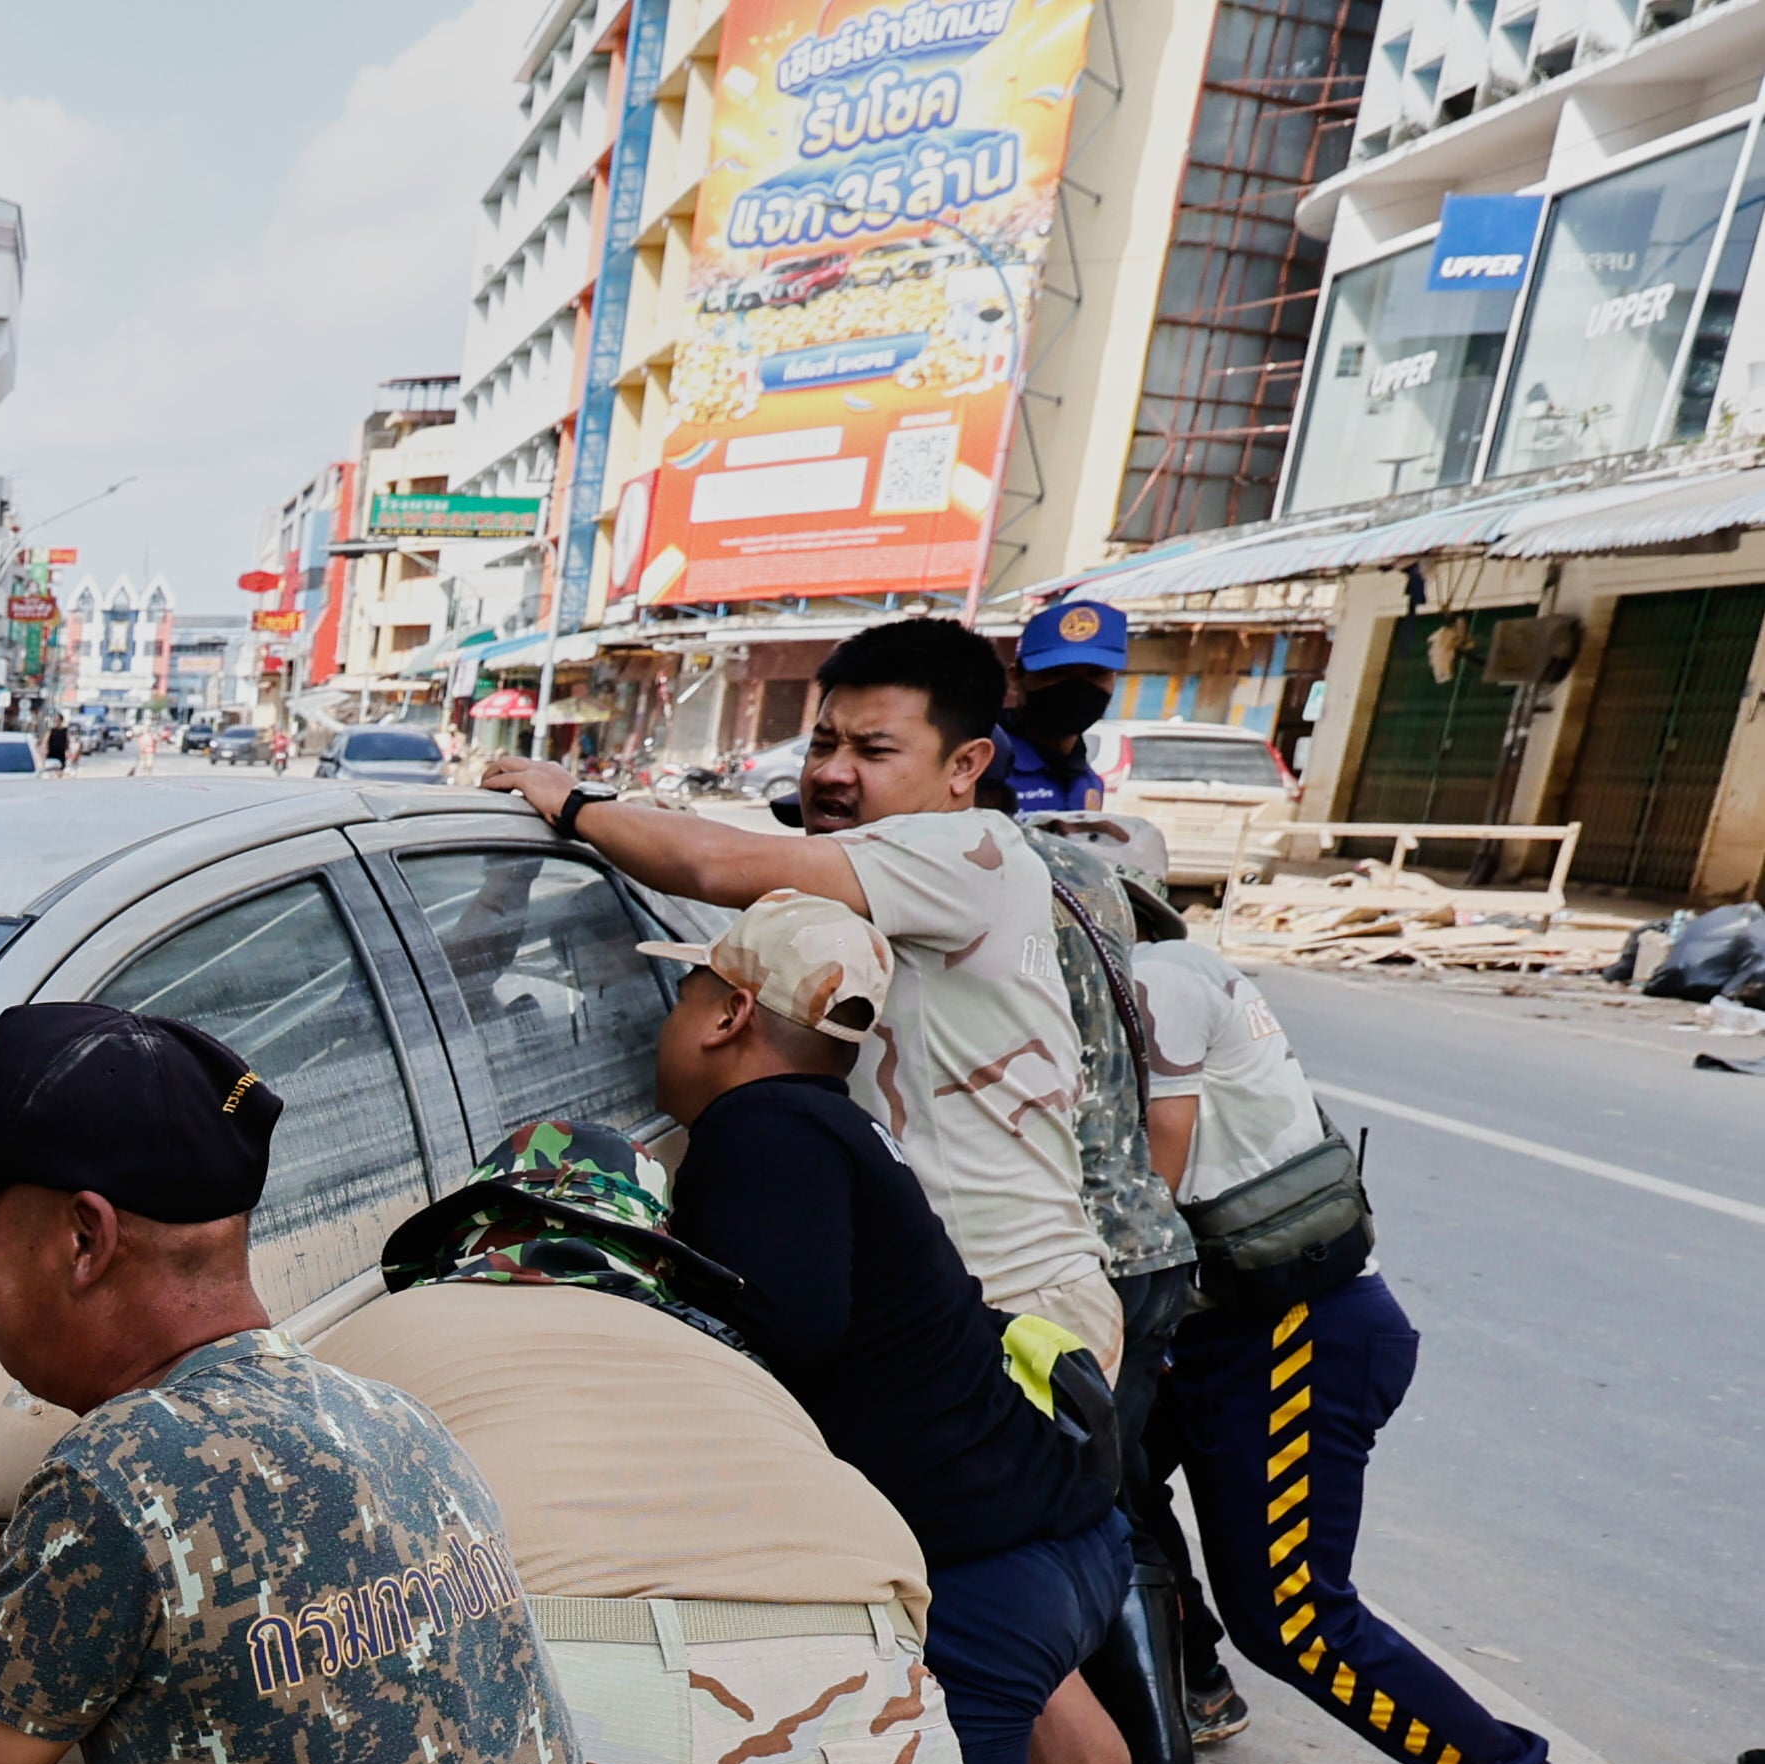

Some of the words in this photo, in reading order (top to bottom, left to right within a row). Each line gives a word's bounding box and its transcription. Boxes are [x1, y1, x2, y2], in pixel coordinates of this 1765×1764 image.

[778, 0, 1011, 91] เชียร์เจ้าซีเกมส
[799, 67, 961, 156] รับโชค
[728, 193, 827, 248] แจก
[830, 164, 906, 234] 35
[905, 140, 1018, 219] ล้าน
[1439, 253, 1525, 279] UPPER
[1584, 282, 1676, 339] UPPER
[1367, 350, 1438, 396] UPPER
